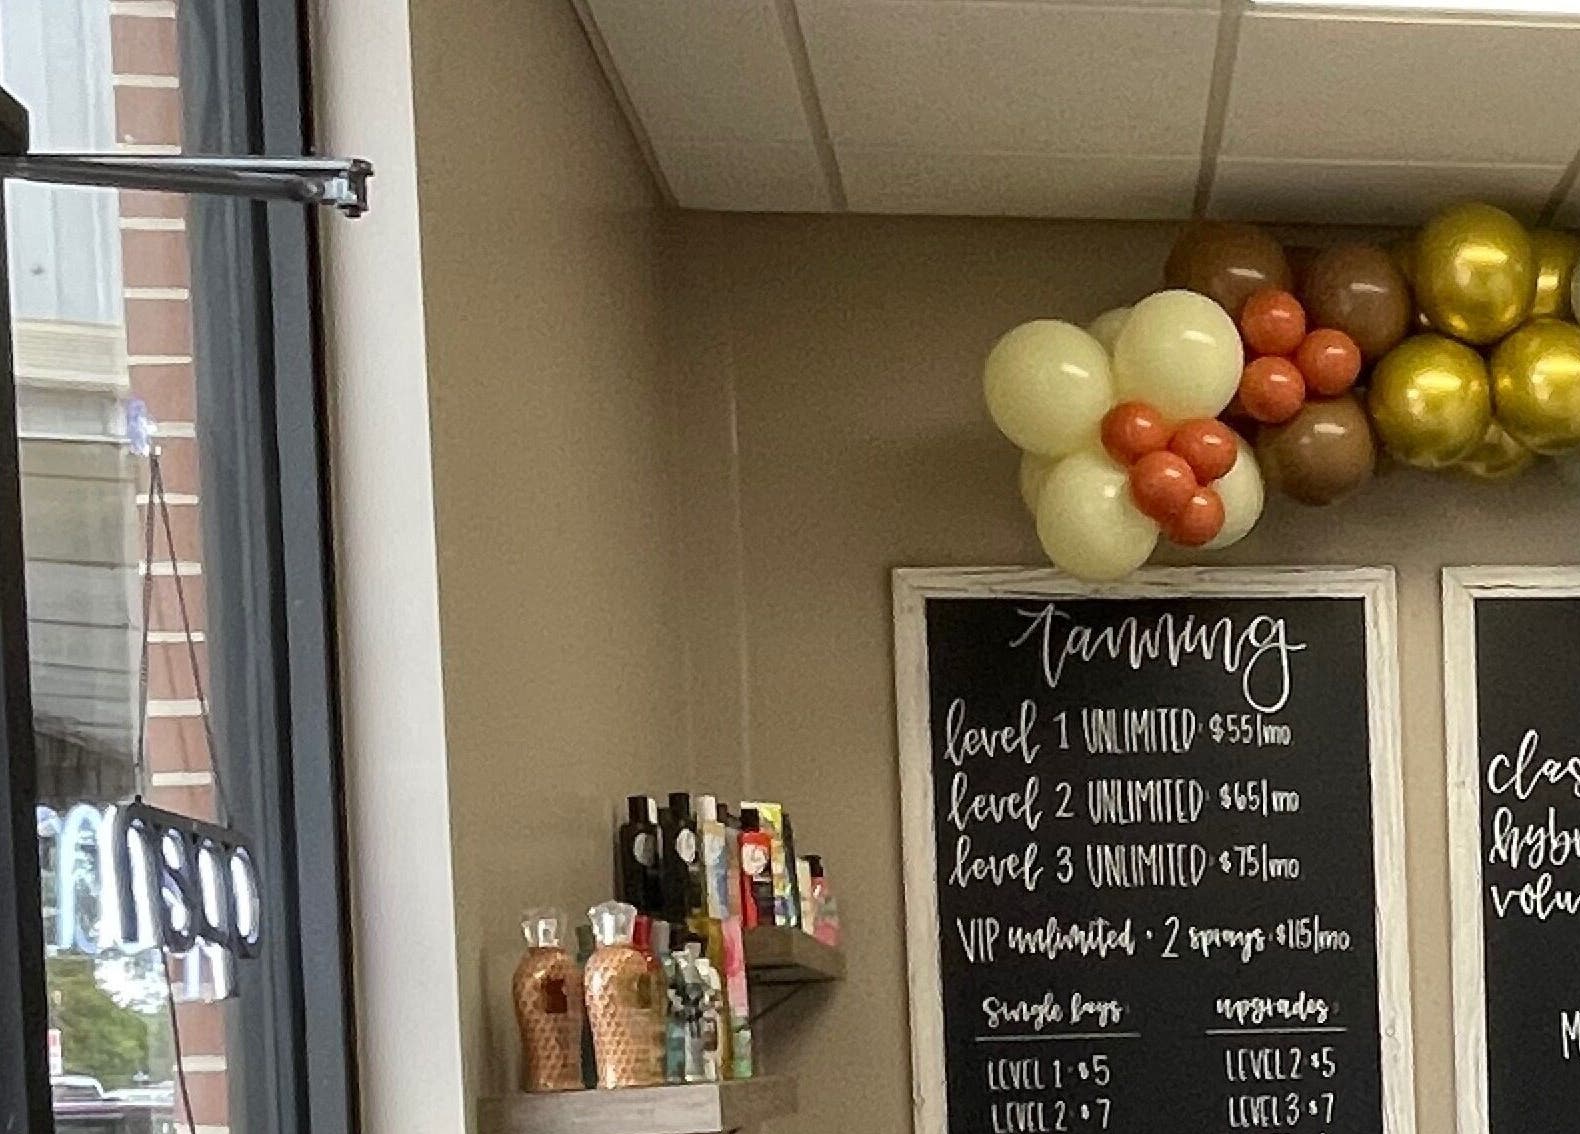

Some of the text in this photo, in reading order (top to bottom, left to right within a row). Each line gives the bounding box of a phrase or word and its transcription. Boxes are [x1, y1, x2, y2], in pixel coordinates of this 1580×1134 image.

[1010, 602, 1308, 715] tanning
[943, 698, 1292, 767] level 1 UNLIMITED $55/mo
[946, 770, 1300, 832] level 2 UNLIMITED $65/mo
[948, 834, 1300, 892] level 3 UNLIMITED $75/mo
[956, 916, 1000, 964] VIP
[1160, 916, 1180, 958] 2
[987, 1058, 1045, 1090] LEVEL
[1078, 1054, 1110, 1086] $5
[1226, 1046, 1336, 1082] LEVEL 2 $5
[990, 1099, 1111, 1134] LEVEL 2 $7
[1228, 1092, 1334, 1128] LEVEL 3 $7
